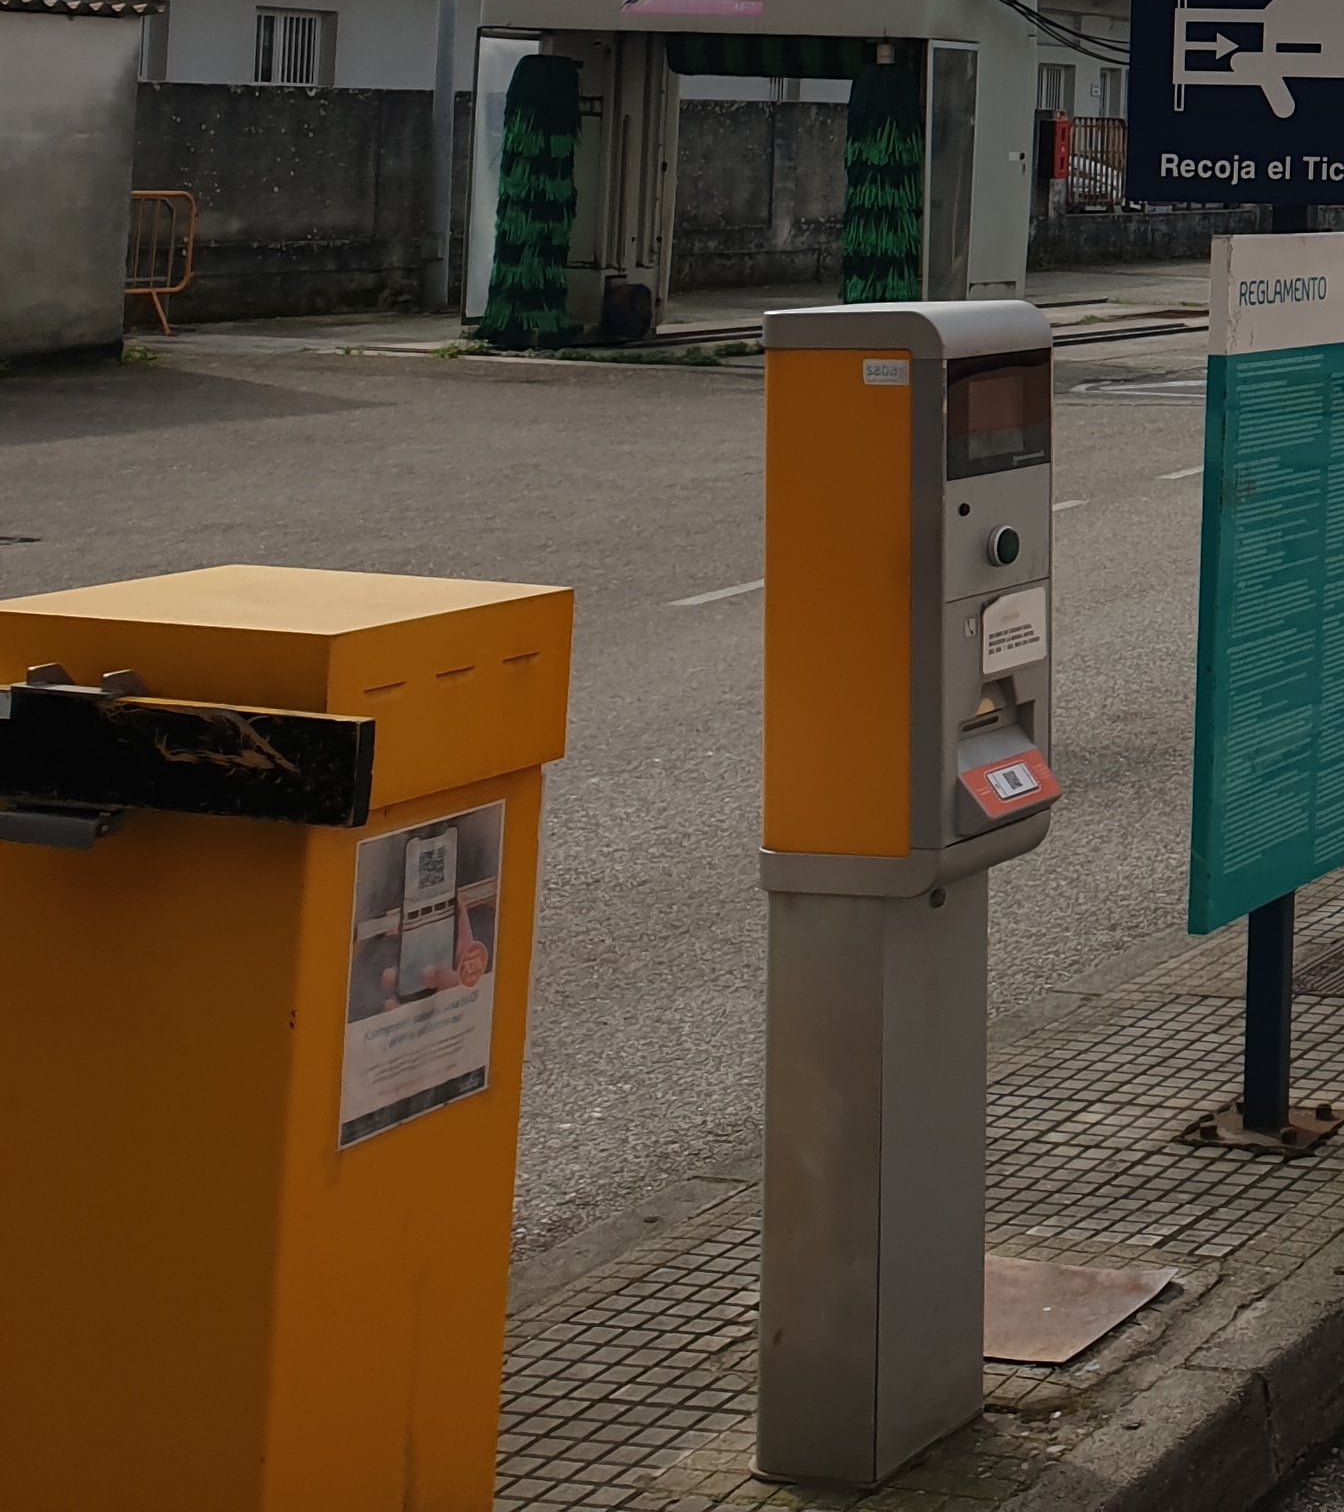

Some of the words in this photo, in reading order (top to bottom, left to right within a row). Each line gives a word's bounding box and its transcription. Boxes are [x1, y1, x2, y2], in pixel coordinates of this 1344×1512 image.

[1160, 153, 1256, 185] Recoja
[1267, 156, 1291, 181] el
[1238, 276, 1328, 306] REGLAMENTO
